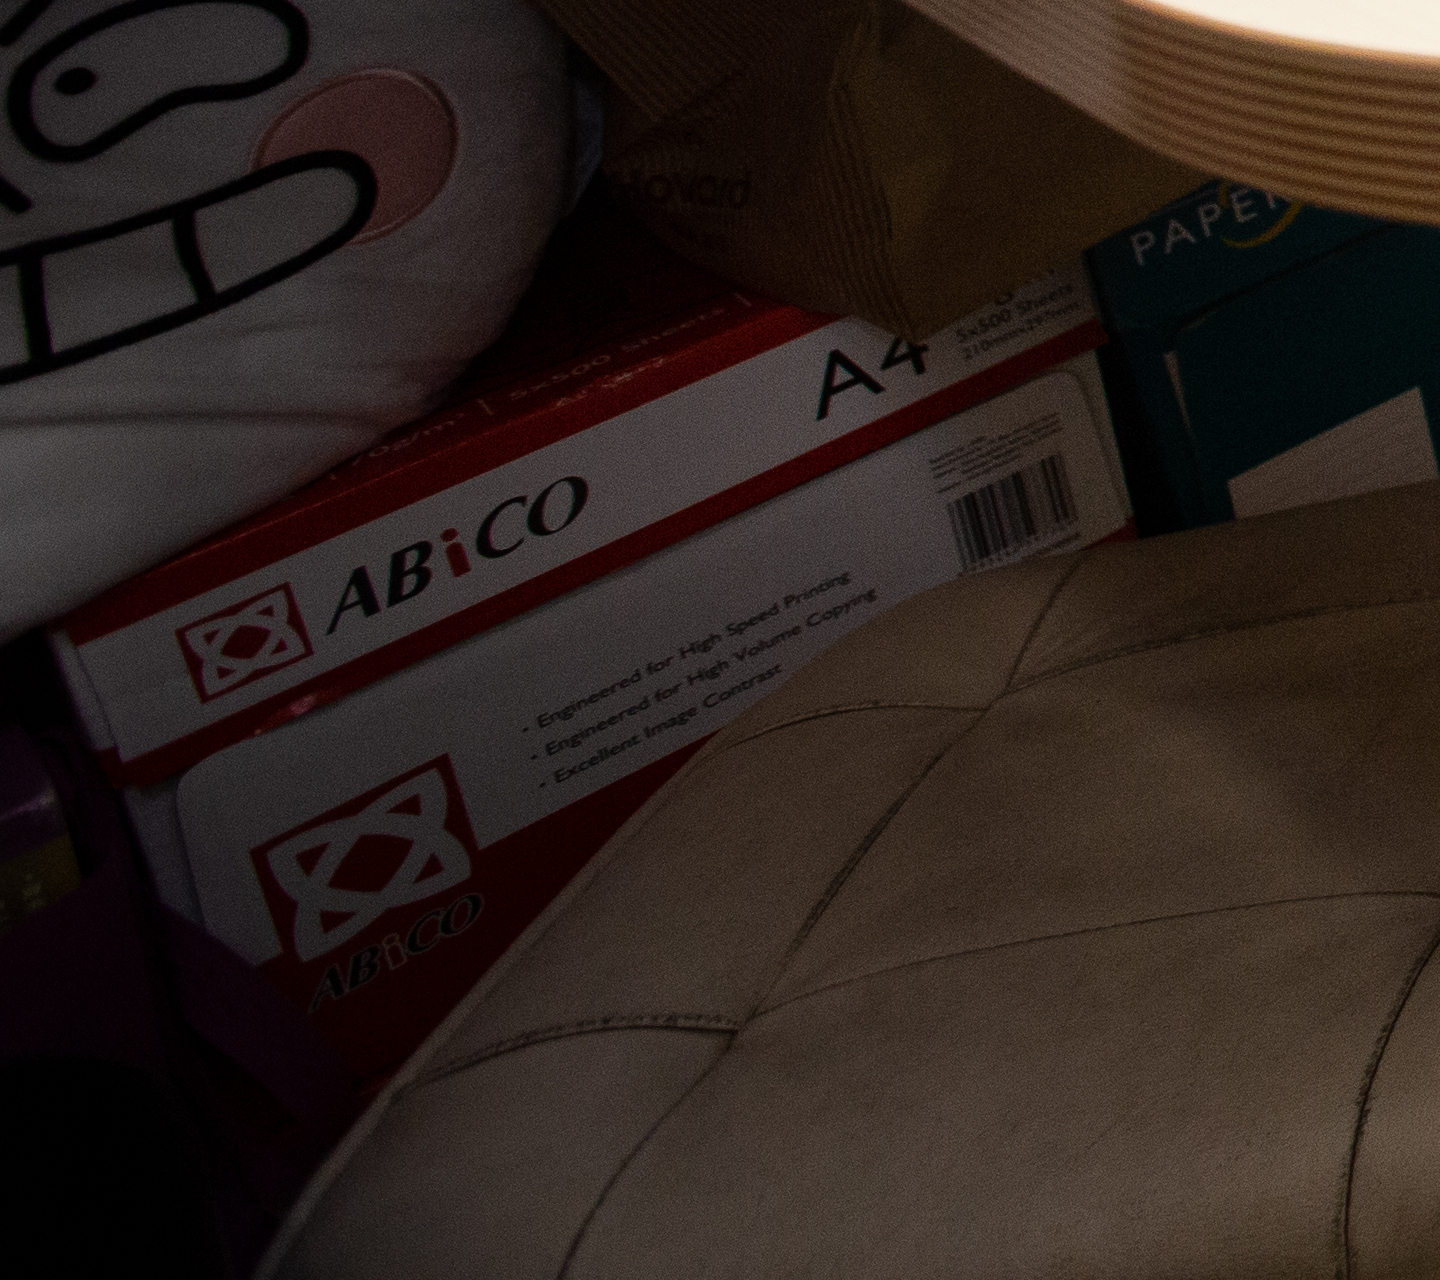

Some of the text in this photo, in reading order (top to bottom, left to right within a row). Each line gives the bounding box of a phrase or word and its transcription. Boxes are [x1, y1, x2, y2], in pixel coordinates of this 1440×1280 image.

[816, 335, 930, 421] A4
[323, 473, 590, 636] ABiCO
[537, 570, 852, 730] Engineered for High Speed Printing
[545, 587, 879, 757] Engineered for High Volume Copying
[553, 662, 783, 786] Excellent Image Contrast
[308, 892, 484, 1013] ABiCO
